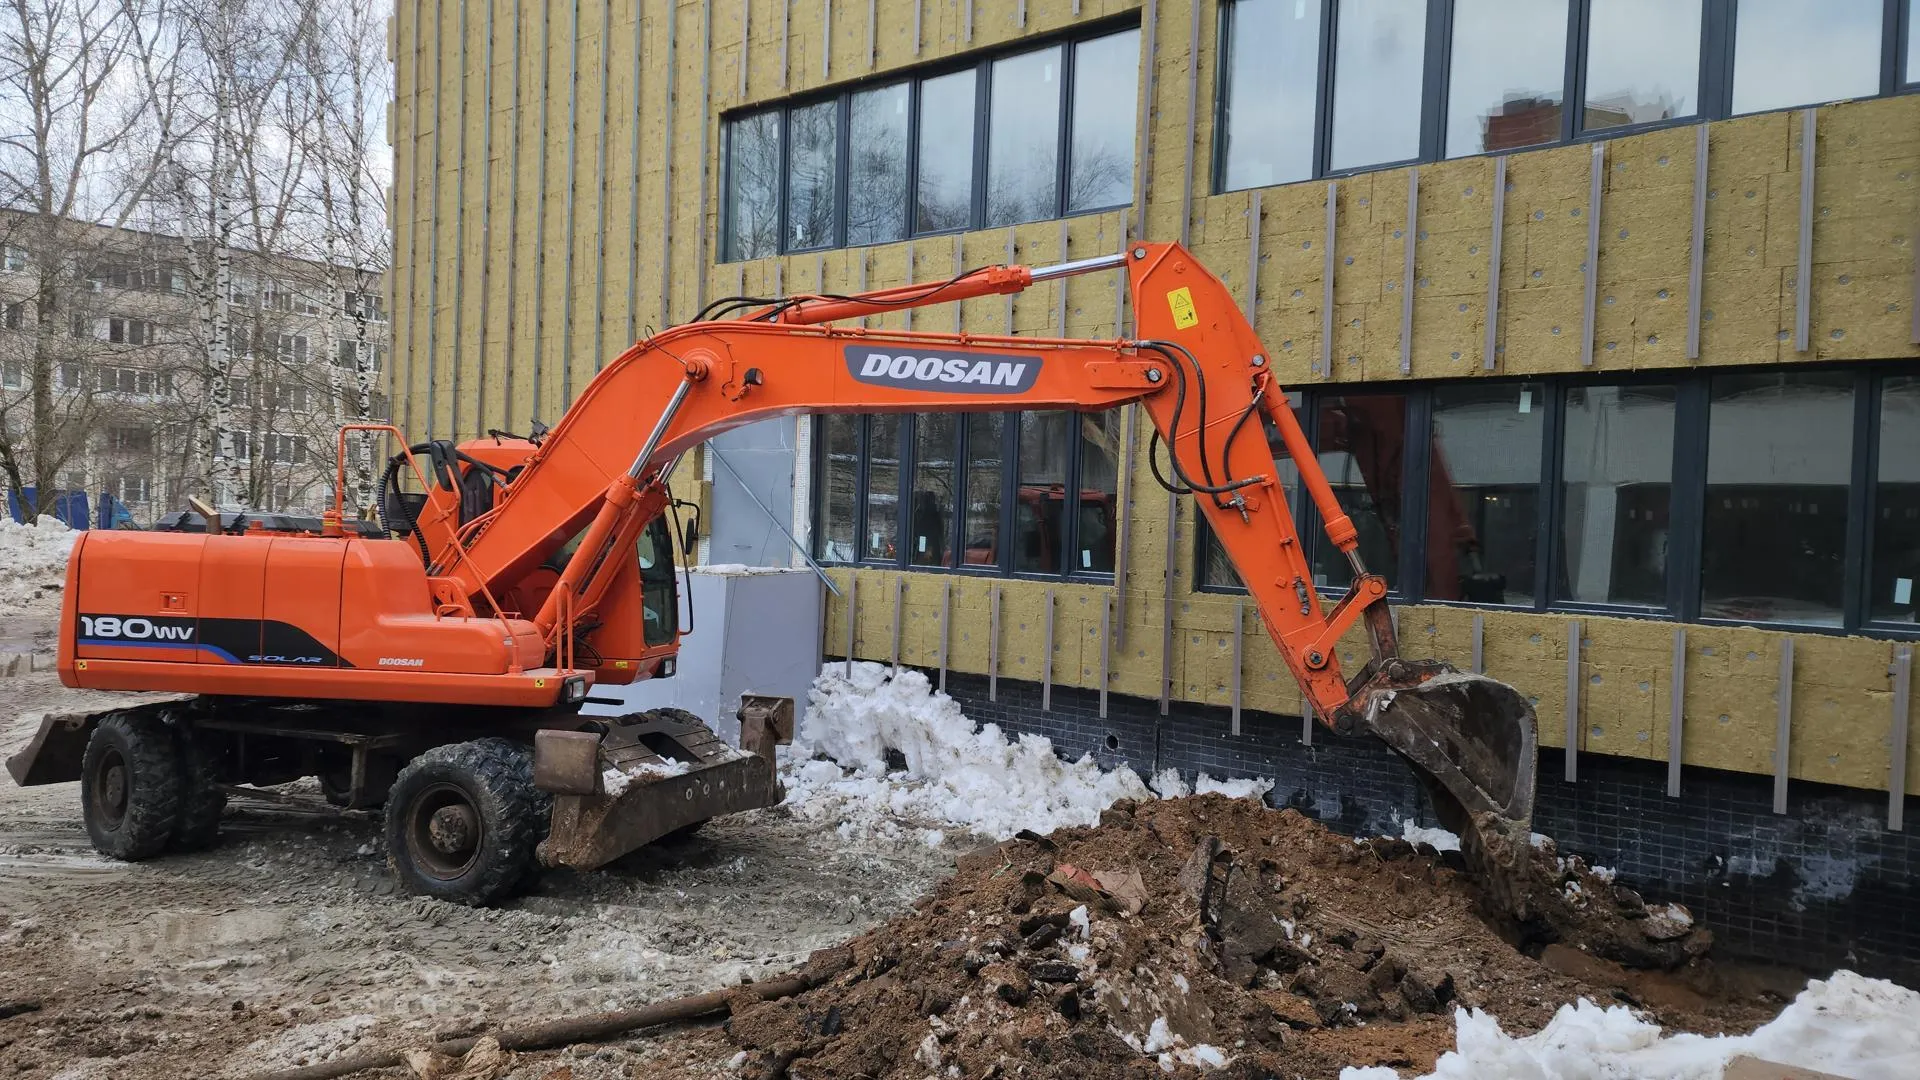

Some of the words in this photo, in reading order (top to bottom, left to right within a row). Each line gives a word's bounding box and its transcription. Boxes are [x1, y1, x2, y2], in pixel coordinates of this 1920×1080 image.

[860, 353, 1026, 387] DOOSAN
[81, 616, 194, 640] 180WV
[248, 655, 323, 663] SOLAR
[378, 657, 424, 667] DOOSAN
